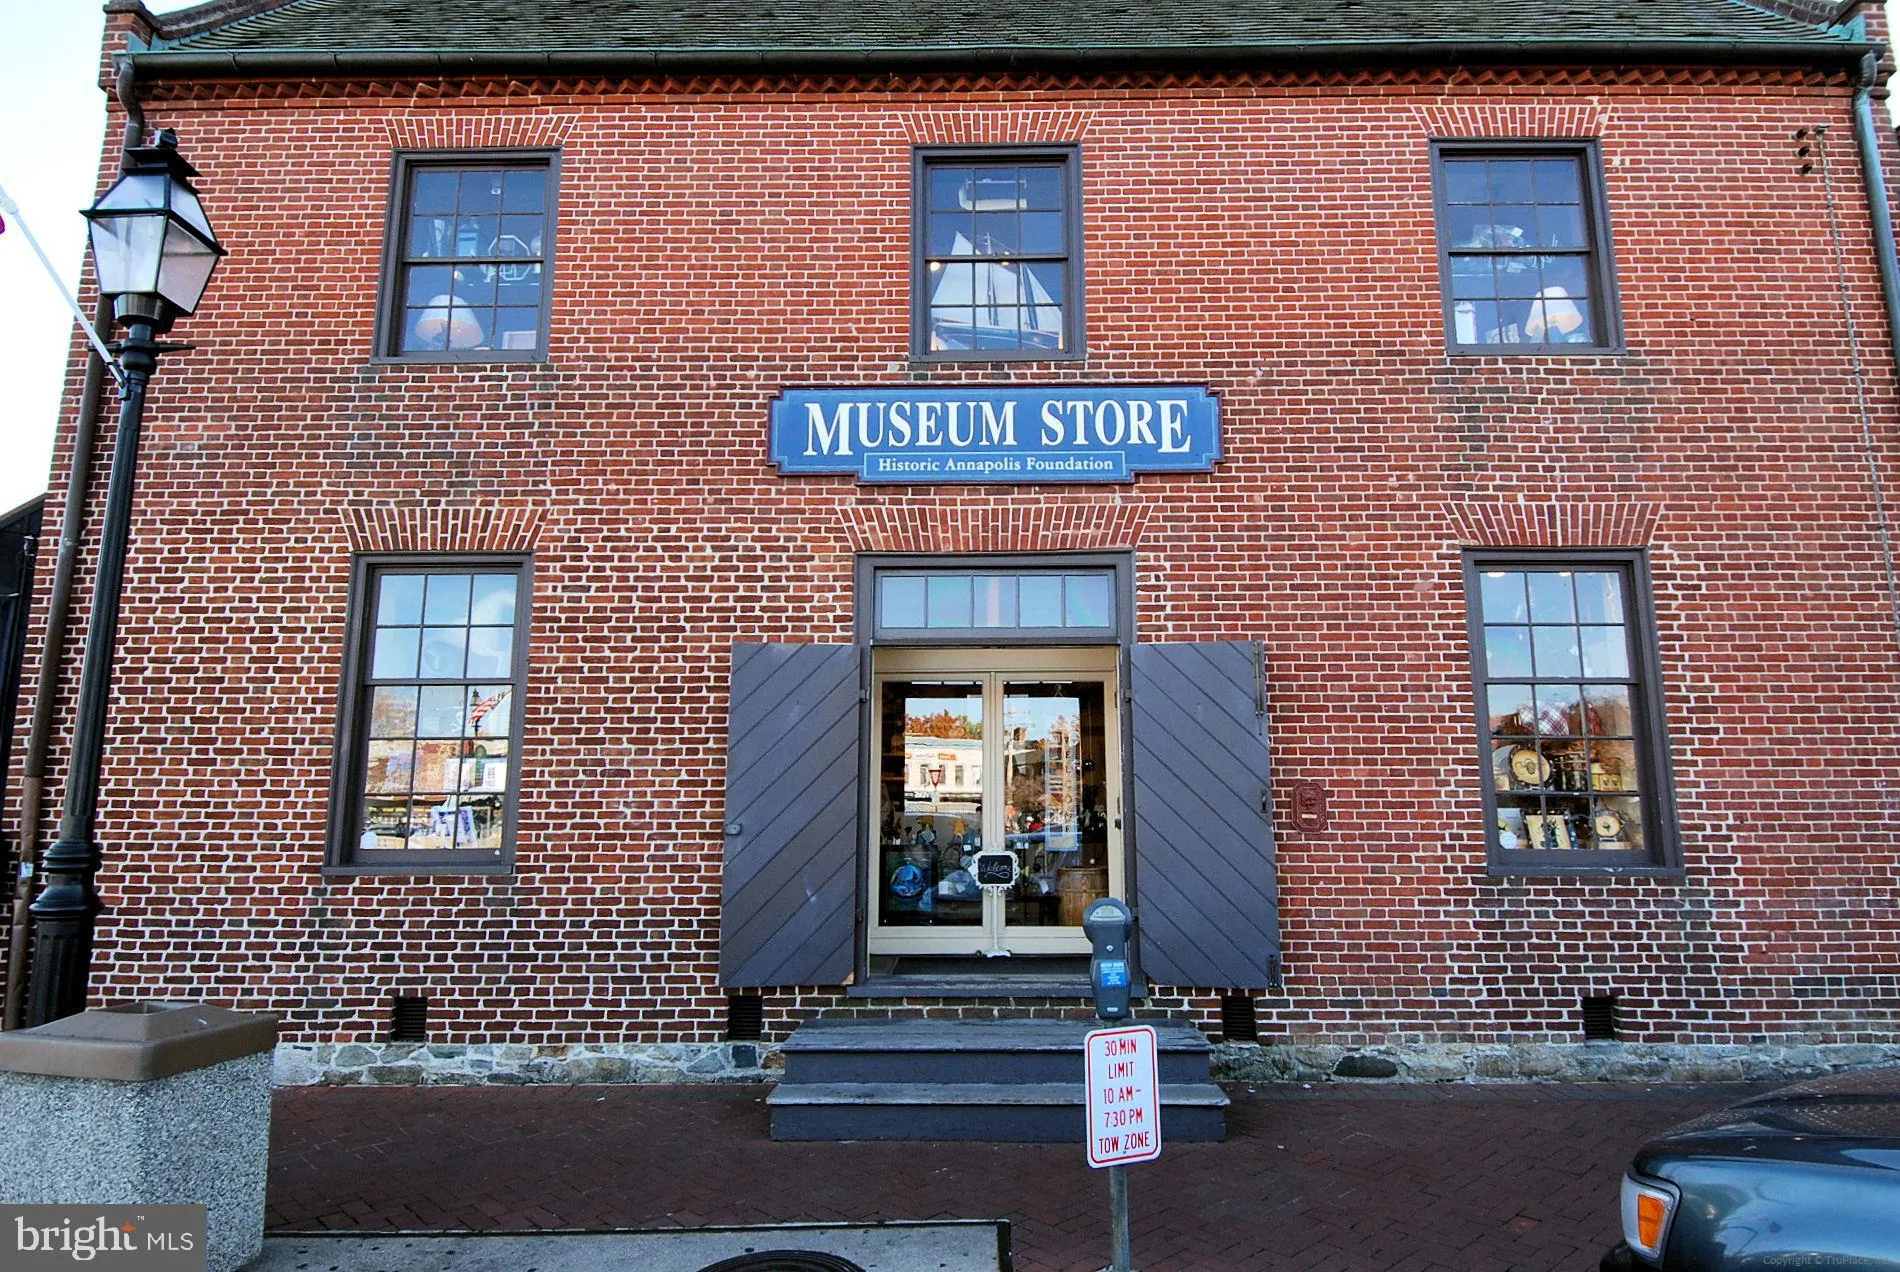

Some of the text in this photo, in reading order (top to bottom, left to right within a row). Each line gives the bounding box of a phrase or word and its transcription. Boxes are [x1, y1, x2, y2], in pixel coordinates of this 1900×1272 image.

[802, 399, 1192, 456] MUSEUM STORE
[878, 455, 1114, 474] Historic Annapolis Foundation
[1104, 1038, 1137, 1057] 30 MIN
[1108, 1061, 1134, 1080] LIMIT
[1103, 1088, 1115, 1105] 10
[1129, 1107, 1143, 1125] PM
[1098, 1131, 1150, 1155] TOW ZONE
